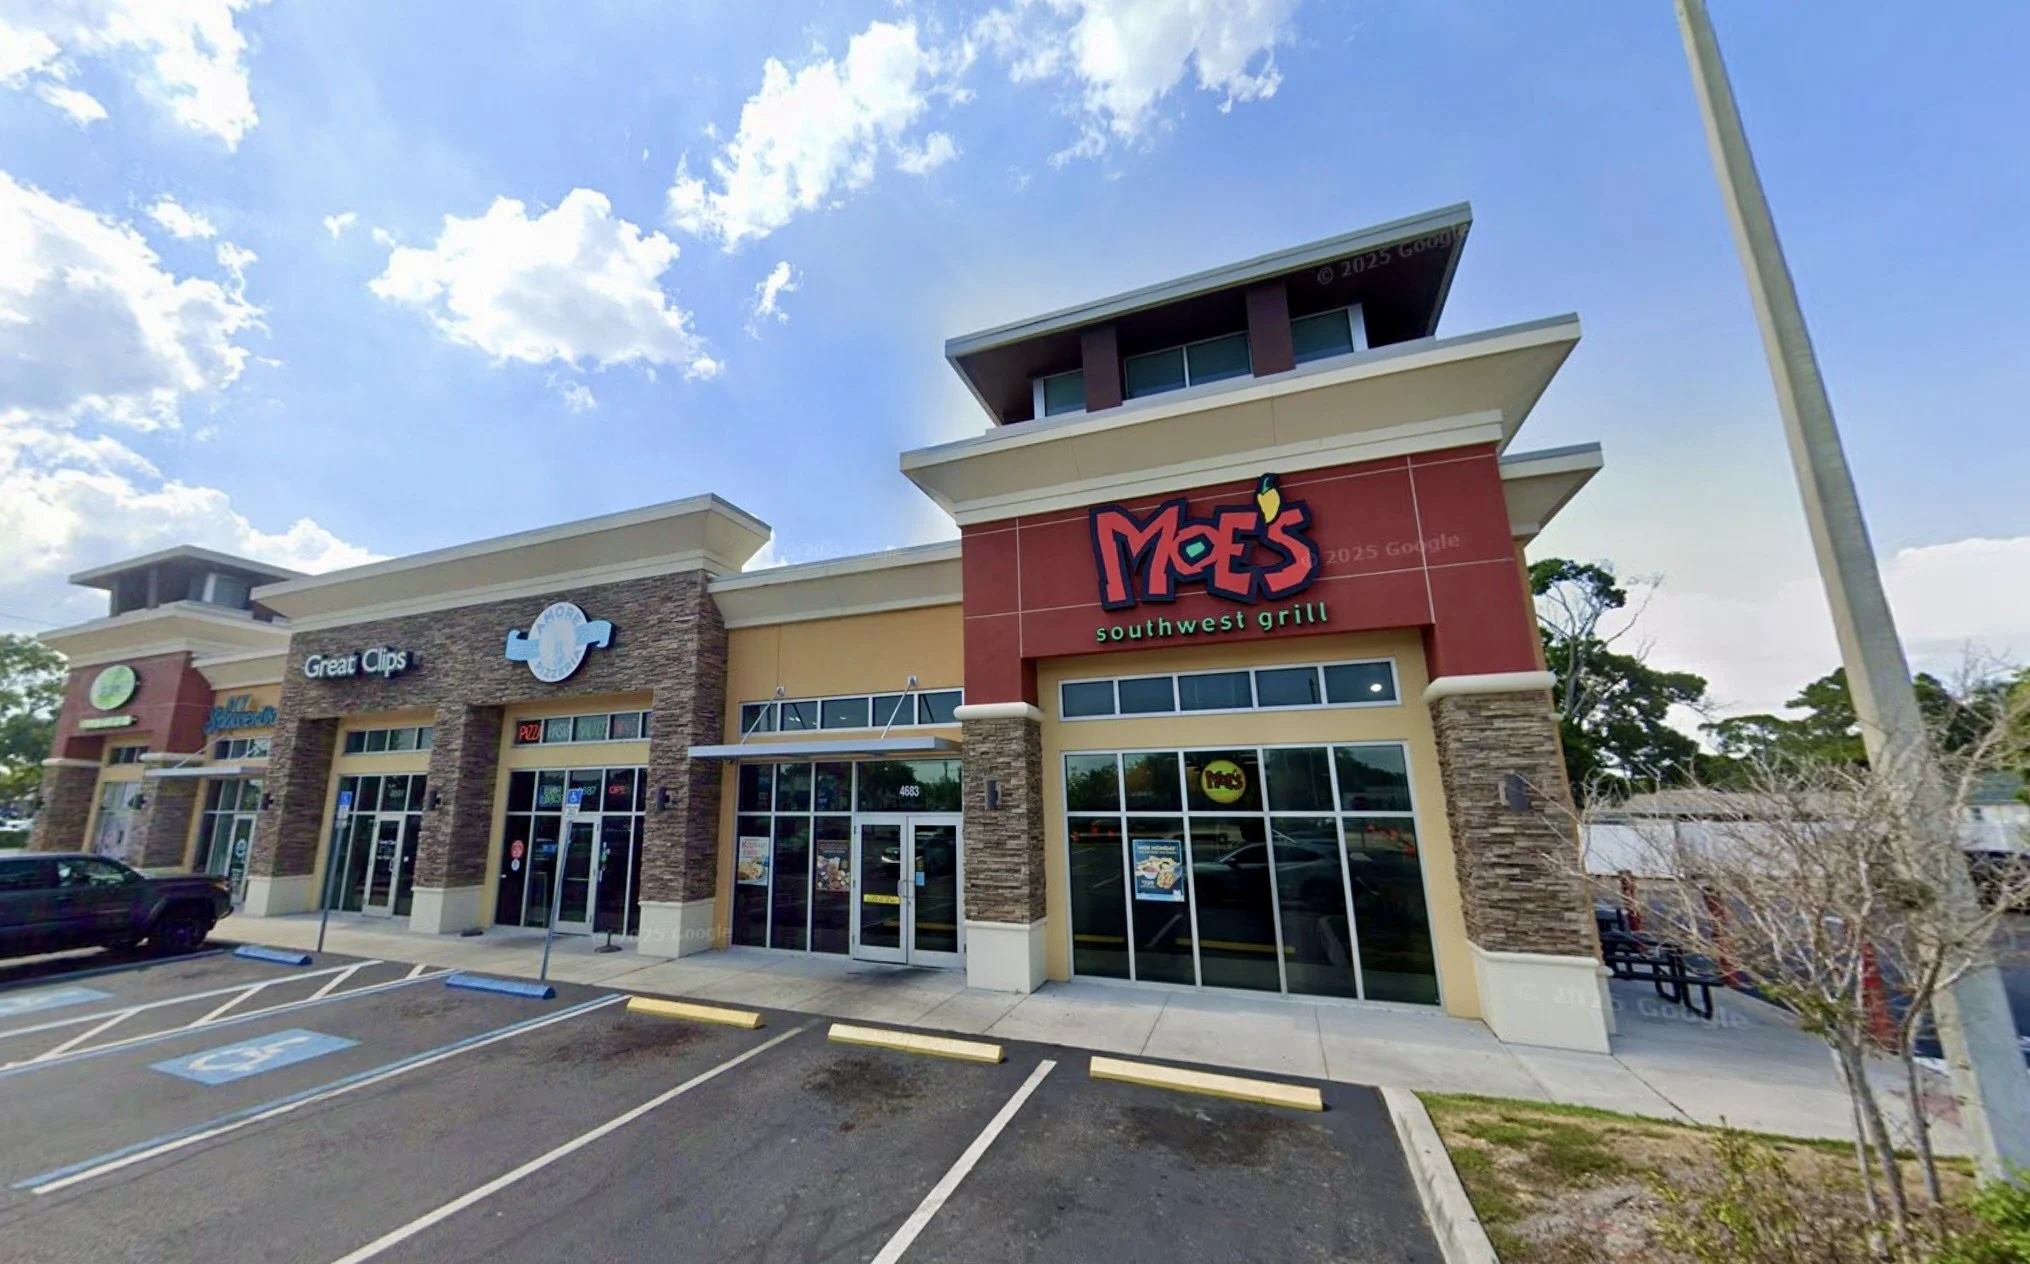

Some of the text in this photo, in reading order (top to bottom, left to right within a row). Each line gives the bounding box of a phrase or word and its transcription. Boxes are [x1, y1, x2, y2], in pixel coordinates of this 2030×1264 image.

[1090, 474, 1319, 611] MOE'S
[536, 605, 582, 635] AMORE
[1096, 602, 1328, 642] southwest grill
[304, 647, 407, 678] Great Clips
[536, 650, 582, 679] PIZZERIA
[900, 785, 919, 797] 4683
